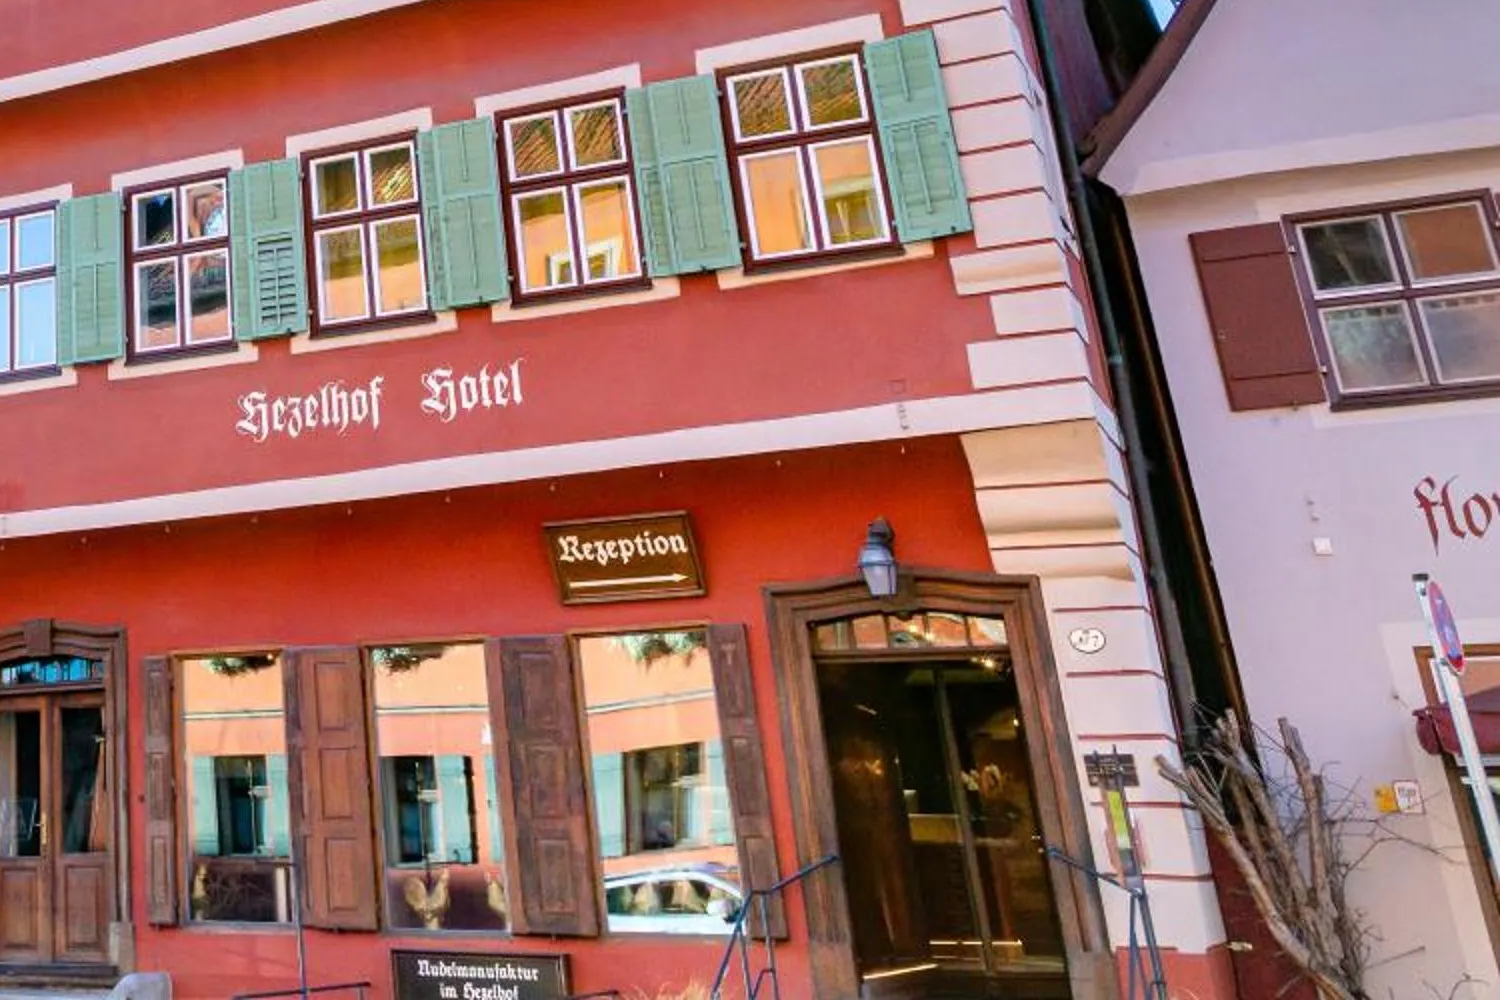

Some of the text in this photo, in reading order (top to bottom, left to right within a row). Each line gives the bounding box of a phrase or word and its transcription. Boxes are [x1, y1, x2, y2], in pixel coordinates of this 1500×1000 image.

[235, 356, 525, 443] Hezelhof Hotel
[558, 530, 689, 567] Rezeption
[417, 959, 540, 982] Nudelmanufaktur
[440, 981, 520, 1000] im Hezelhof
